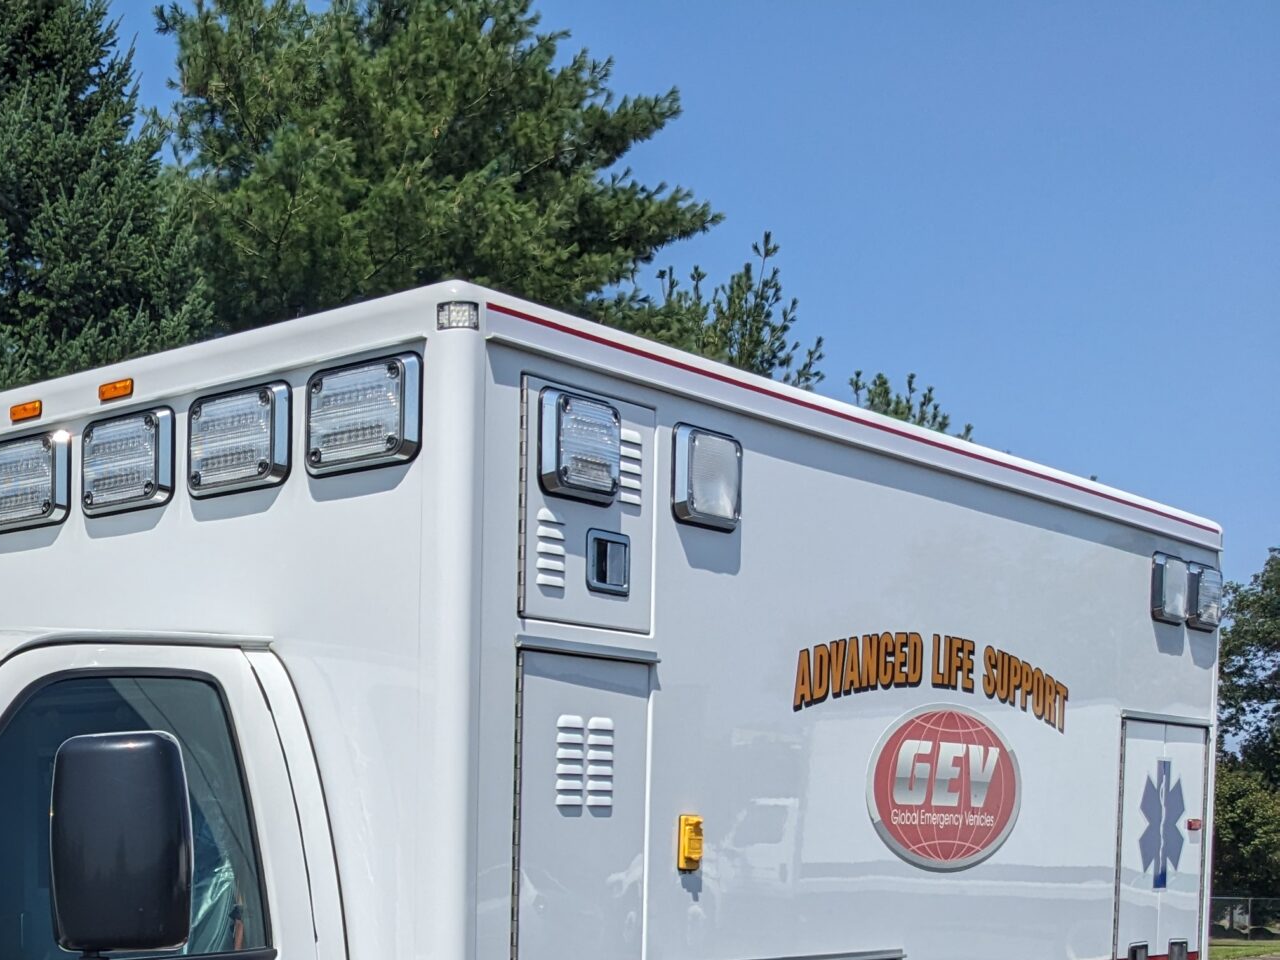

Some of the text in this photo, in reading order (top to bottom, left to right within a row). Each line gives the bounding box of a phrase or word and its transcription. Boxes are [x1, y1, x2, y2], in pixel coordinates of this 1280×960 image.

[793, 632, 1068, 734] ADVANCED LIFE SUPPORT
[892, 739, 1000, 807] GEV
[891, 809, 994, 828] Global Emergency Vehicles
